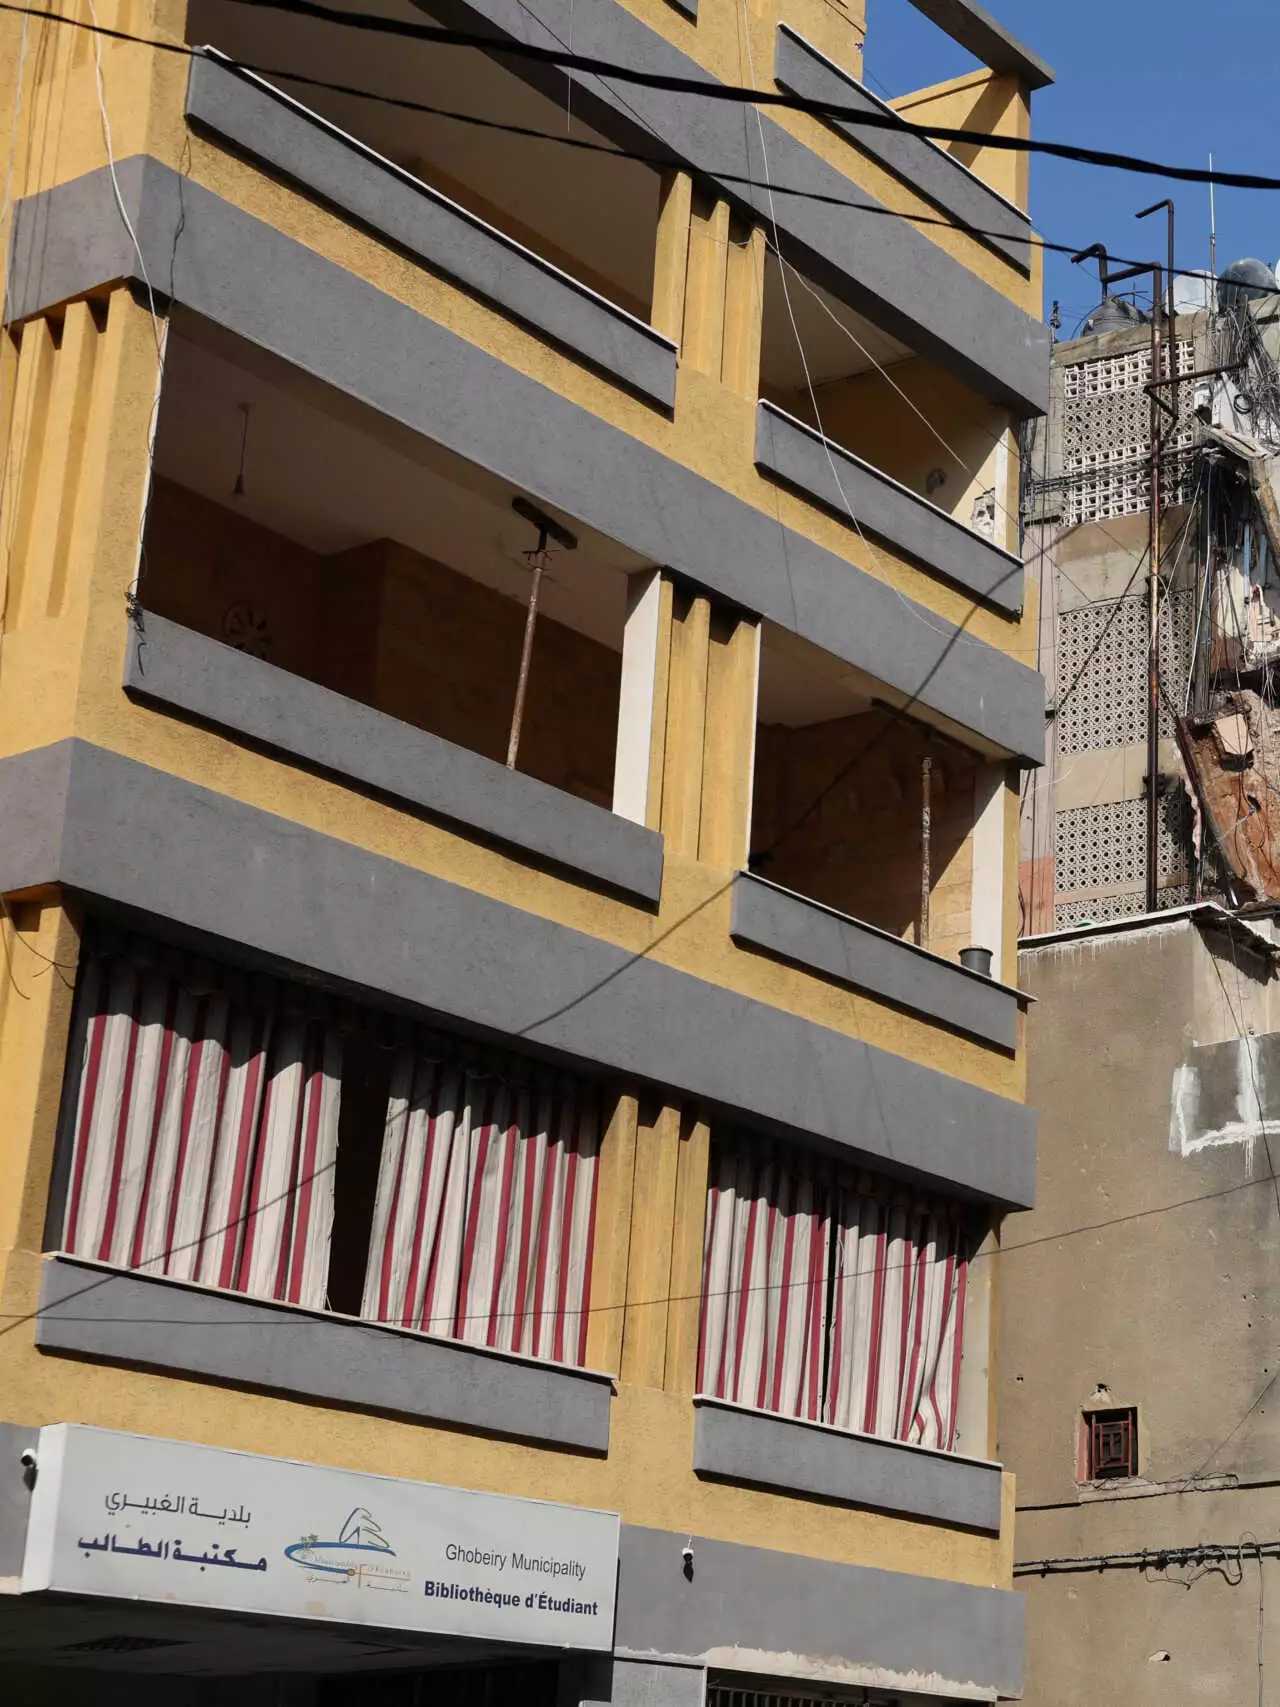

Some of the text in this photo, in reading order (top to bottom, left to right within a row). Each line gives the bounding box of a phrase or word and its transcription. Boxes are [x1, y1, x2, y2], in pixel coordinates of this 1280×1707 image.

[104, 1492, 251, 1528] بلدية الغبيري
[77, 1533, 267, 1572] مكتبة الطالب
[445, 1543, 507, 1571] Ghobeiry
[511, 1552, 586, 1581] Municipality
[424, 1580, 521, 1608] Bibliothèque
